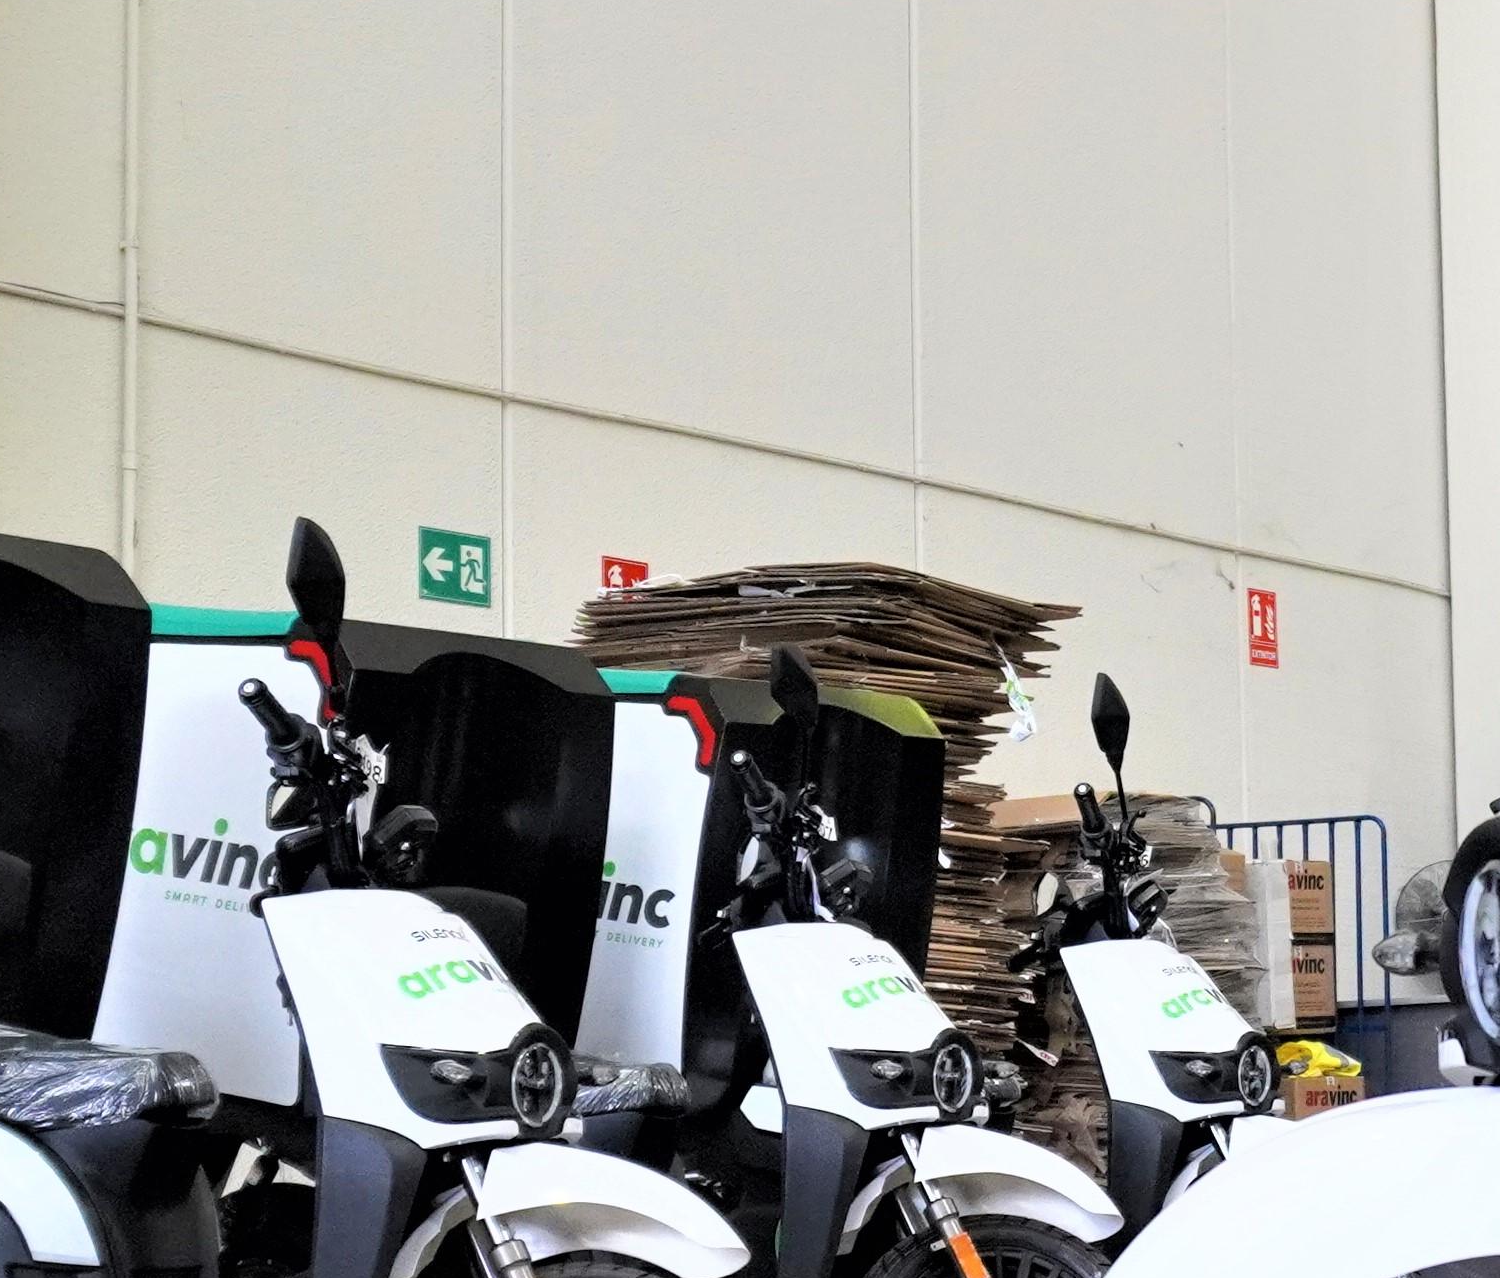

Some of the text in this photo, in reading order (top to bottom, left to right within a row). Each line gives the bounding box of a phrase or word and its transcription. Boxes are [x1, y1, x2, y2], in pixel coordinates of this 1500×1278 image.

[1288, 869, 1324, 890] avinc
[164, 890, 208, 907] SMART
[607, 932, 664, 948] DELIVERY
[1306, 1086, 1357, 1108] aravinc
